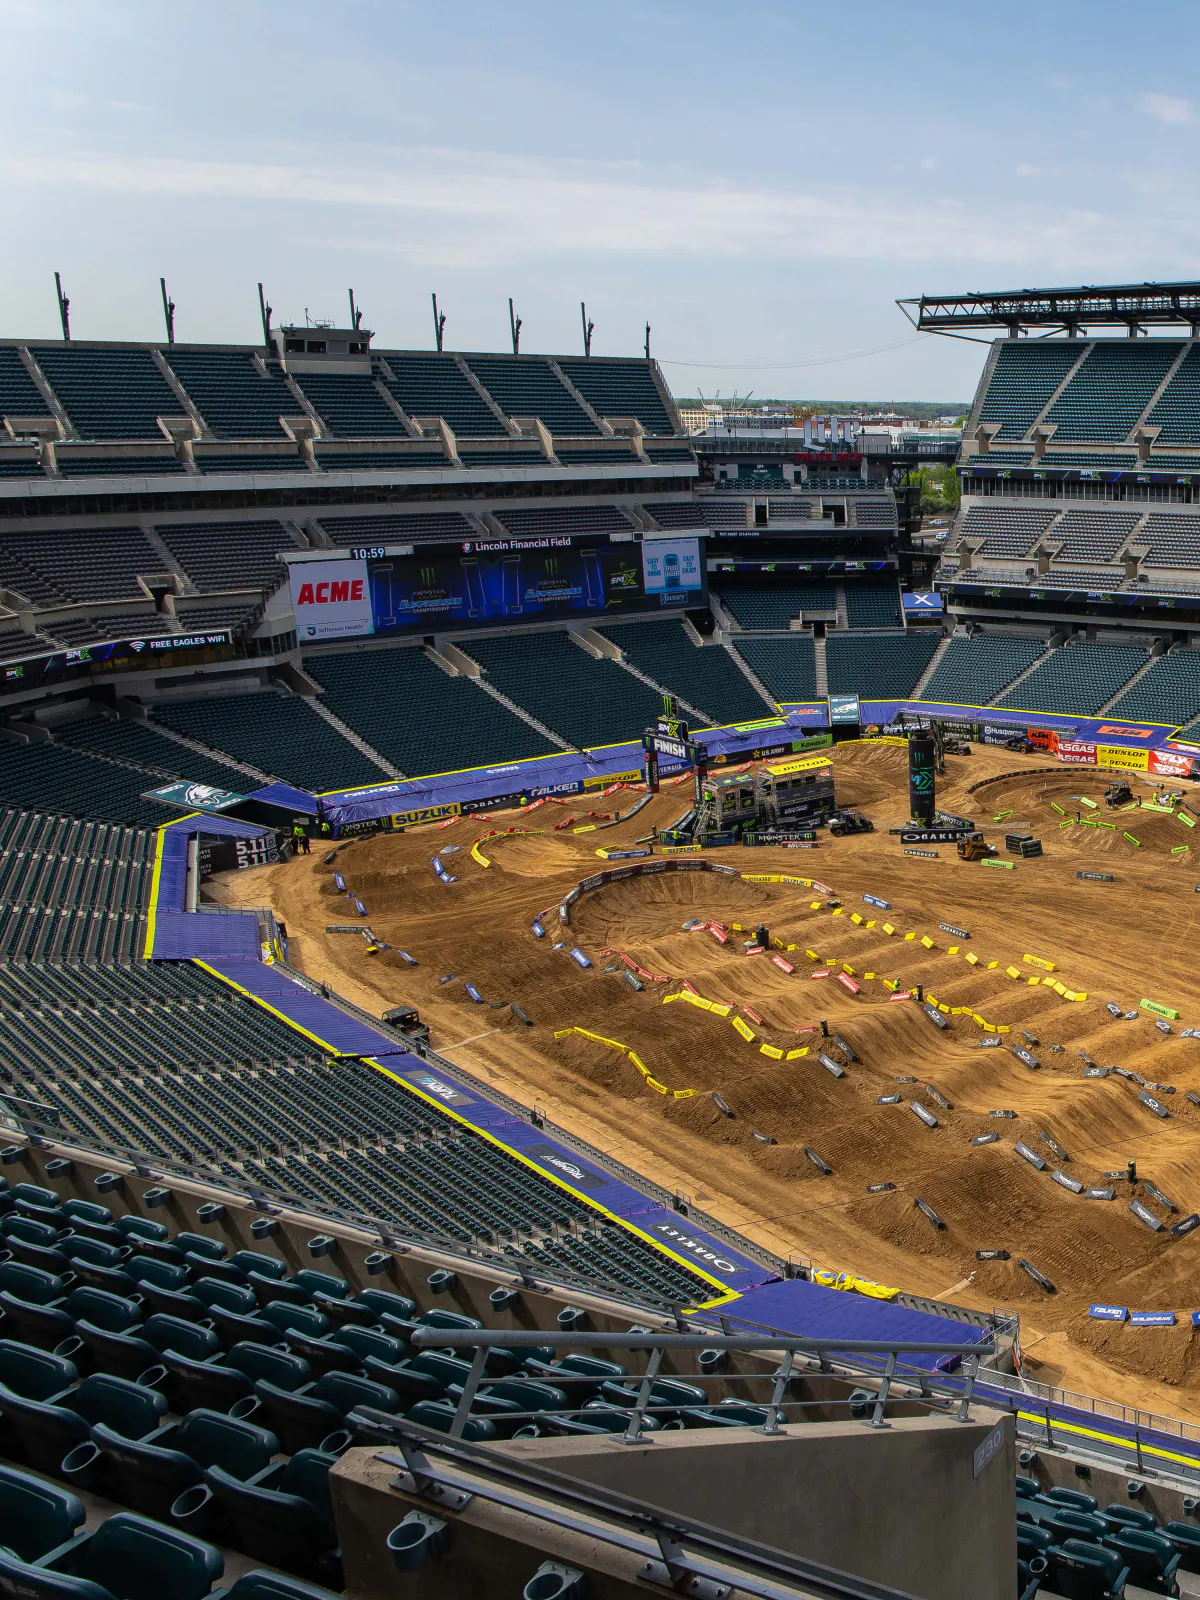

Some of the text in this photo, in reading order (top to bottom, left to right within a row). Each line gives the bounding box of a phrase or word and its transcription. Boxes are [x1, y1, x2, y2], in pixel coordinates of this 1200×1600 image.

[475, 536, 571, 552] Lincoln Financial Field
[353, 547, 385, 560] 10:59
[298, 580, 364, 605] ACME
[151, 635, 225, 649] FREE EAGLES WIFI
[658, 723, 678, 738] SMX
[654, 738, 686, 758] FINISH
[1058, 743, 1095, 754] ASGAS
[1108, 749, 1146, 758] DUNLOP
[1058, 754, 1095, 765] ASGAS
[395, 805, 458, 826] SUZUKI
[236, 840, 267, 855] 5.11
[540, 1155, 585, 1180] TRIUMPH
[657, 1225, 716, 1260] OAKLEY
[1094, 1307, 1122, 1316] FALKEN
[977, 1430, 1001, 1469] 230
